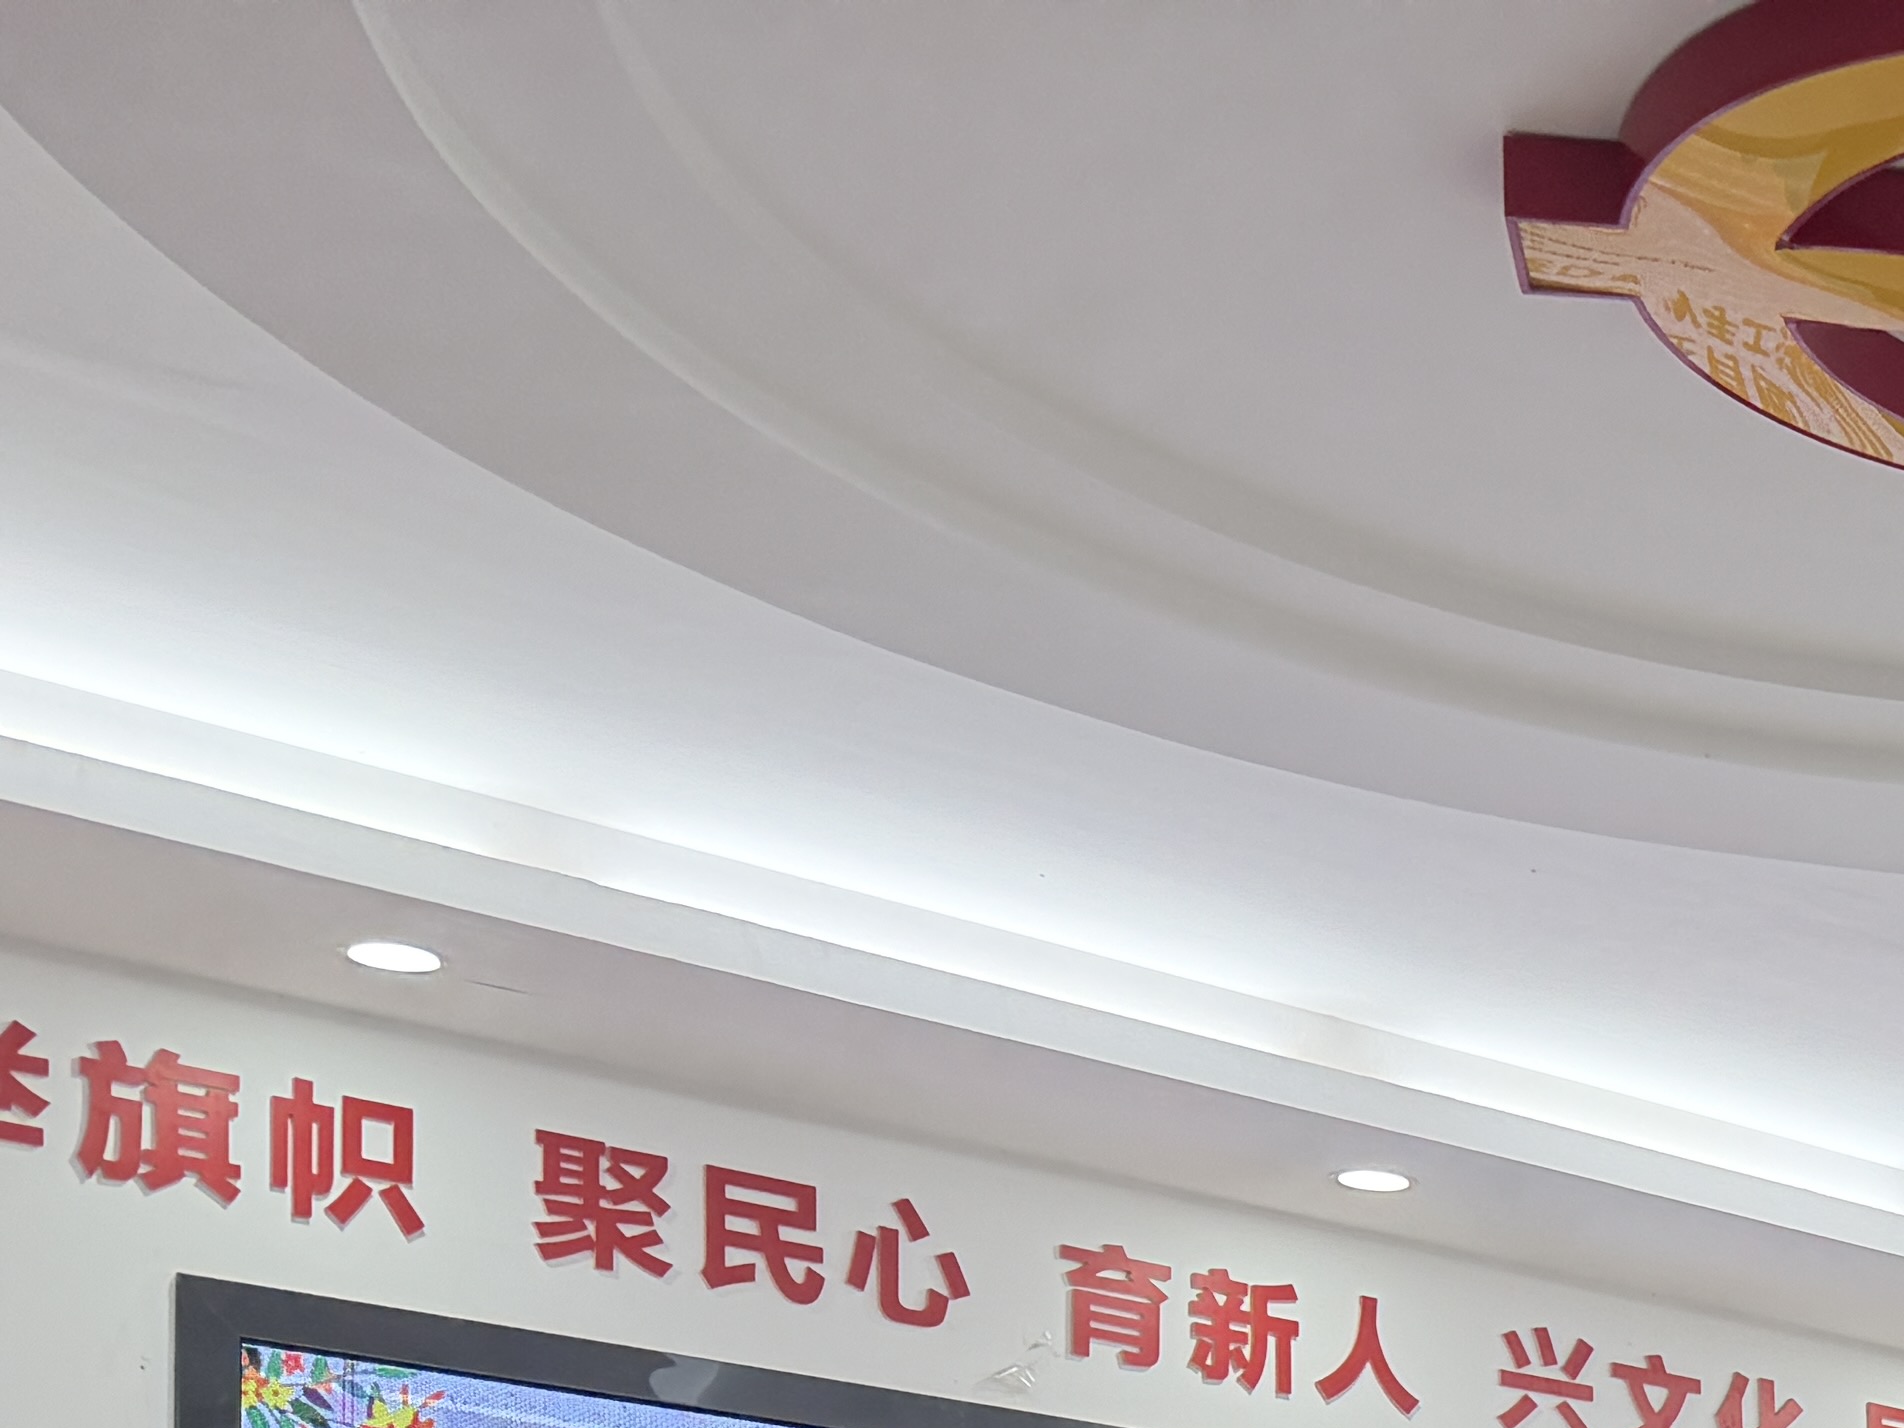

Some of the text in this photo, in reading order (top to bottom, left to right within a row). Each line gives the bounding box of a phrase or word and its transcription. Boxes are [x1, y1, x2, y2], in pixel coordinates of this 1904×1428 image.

[533, 1128, 972, 1329] 聚民心
[1060, 1244, 1420, 1416] 育新人
